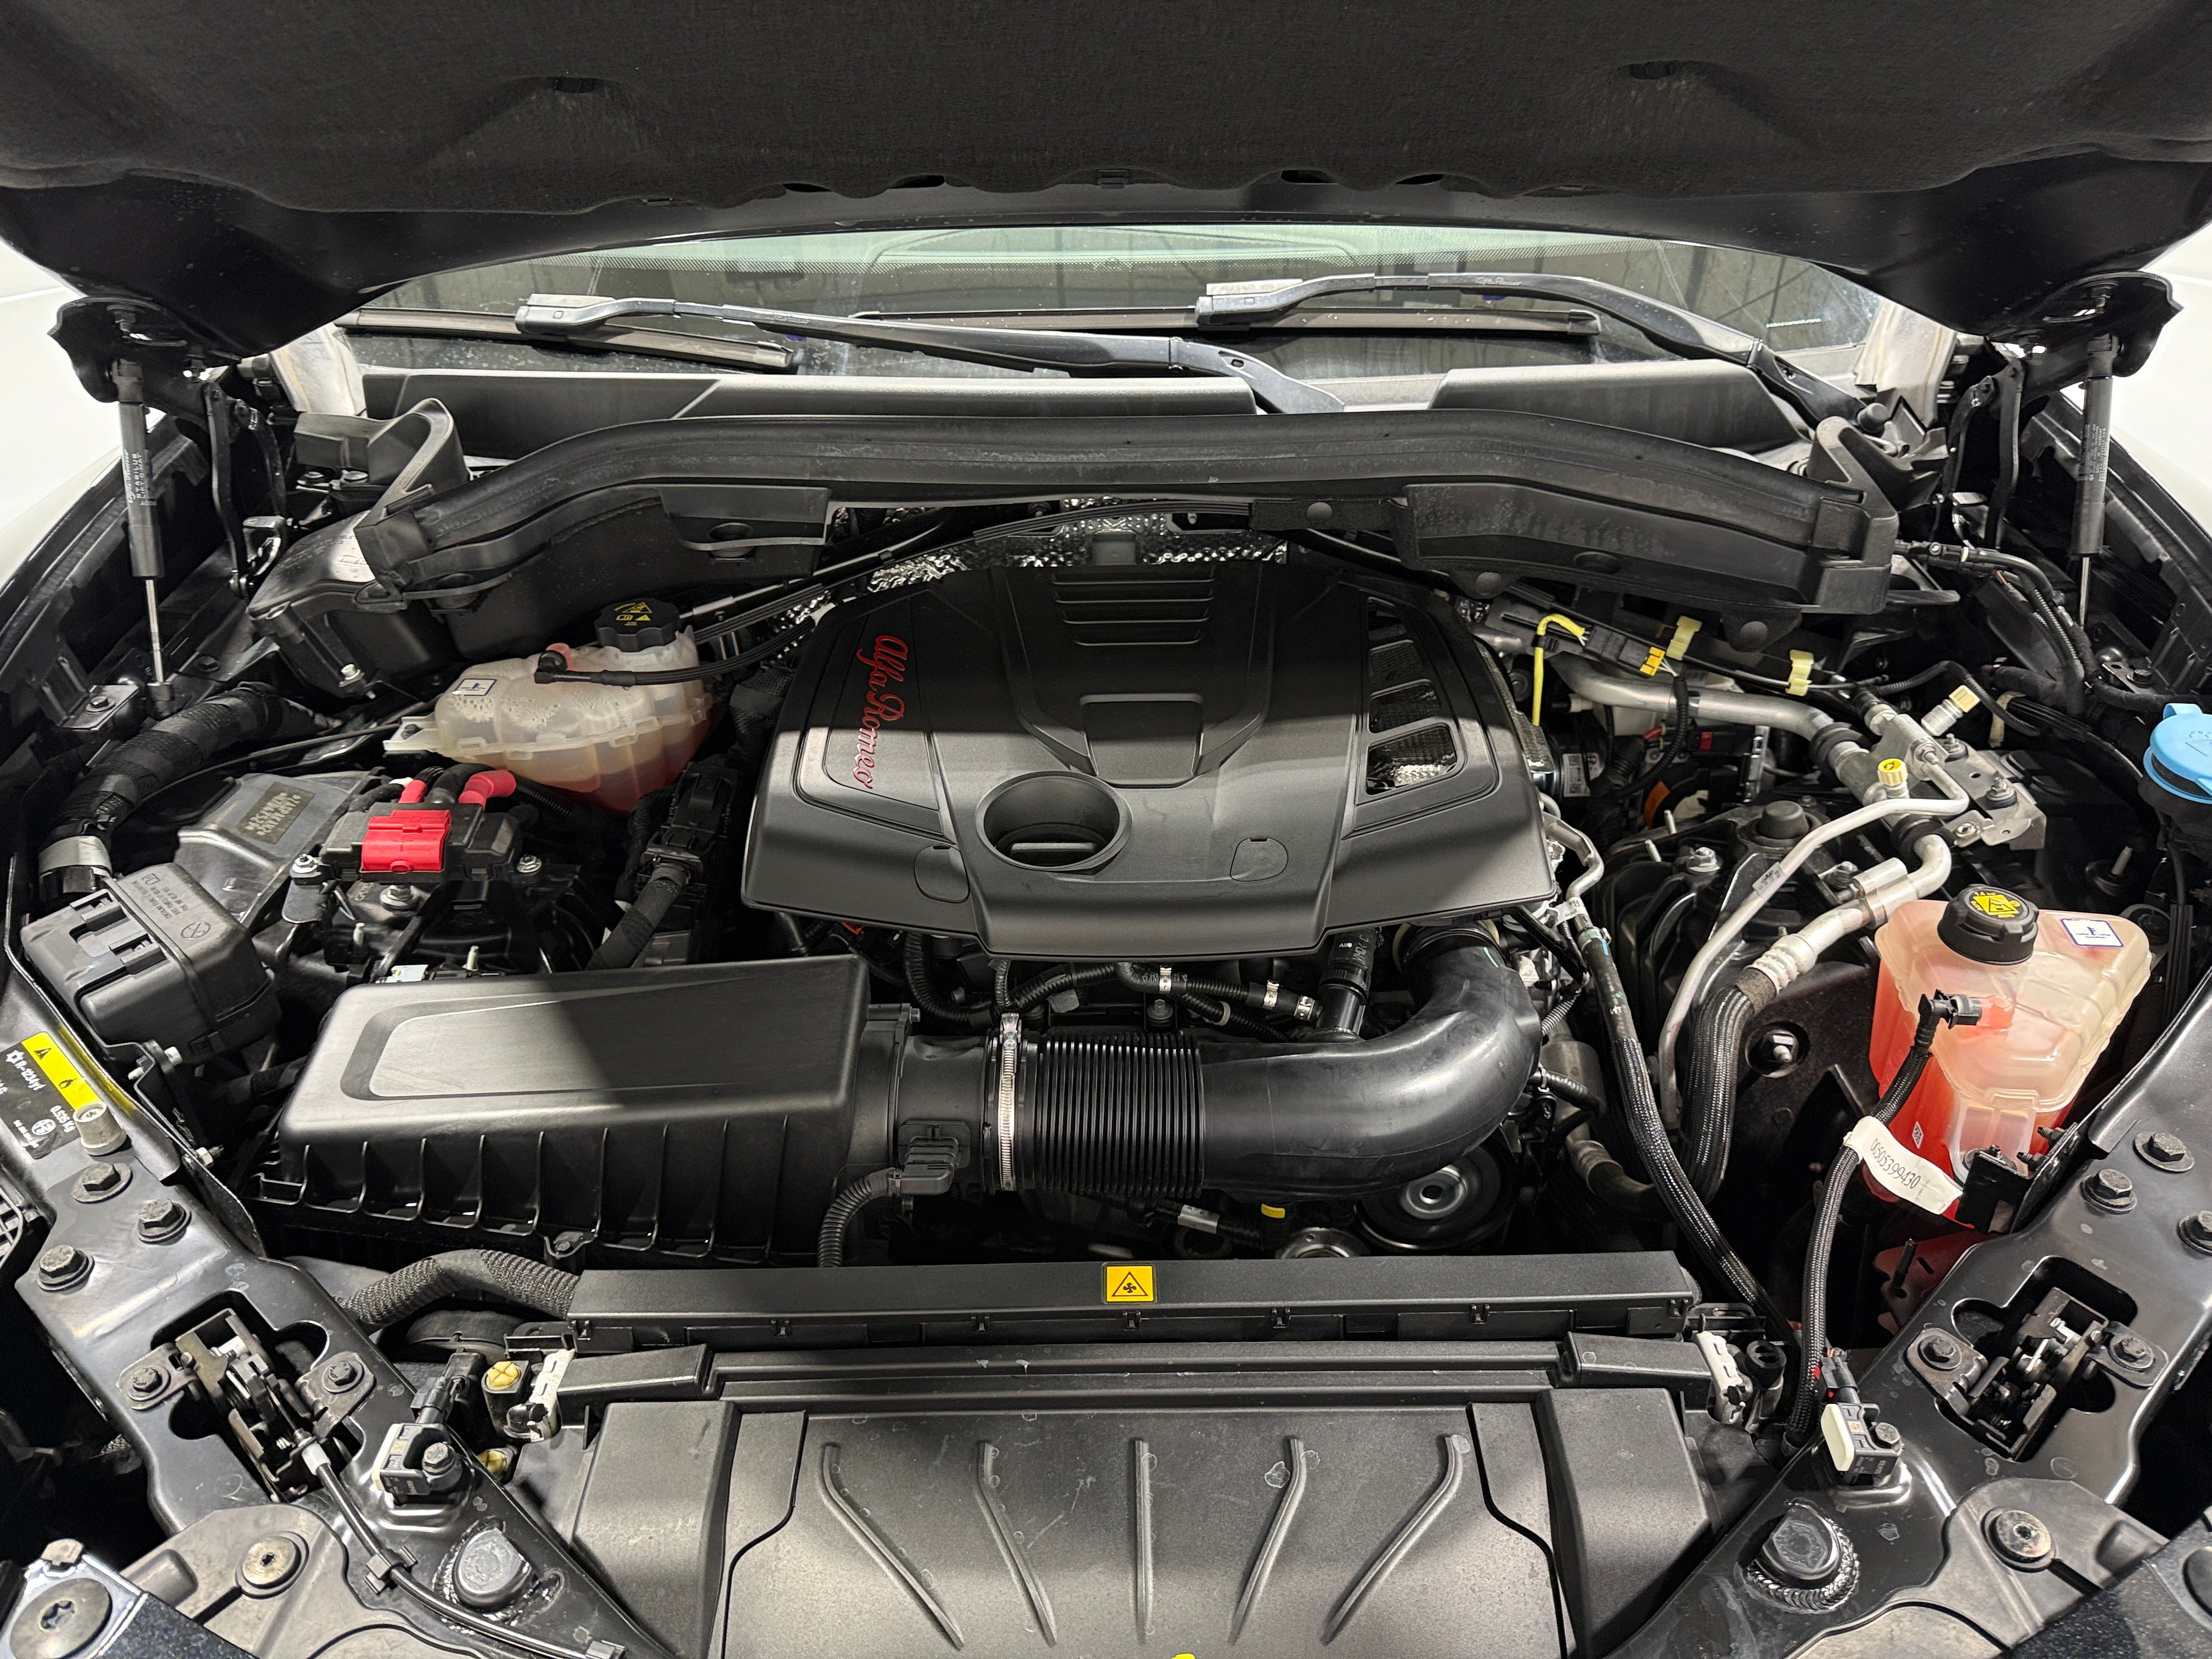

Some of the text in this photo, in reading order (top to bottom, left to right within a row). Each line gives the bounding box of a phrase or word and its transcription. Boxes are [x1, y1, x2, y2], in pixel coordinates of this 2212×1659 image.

[853, 635, 909, 789] Alfa Romeo
[14, 1060, 47, 1091] R-1234yf
[1870, 1138, 1921, 1189] 00505399430
